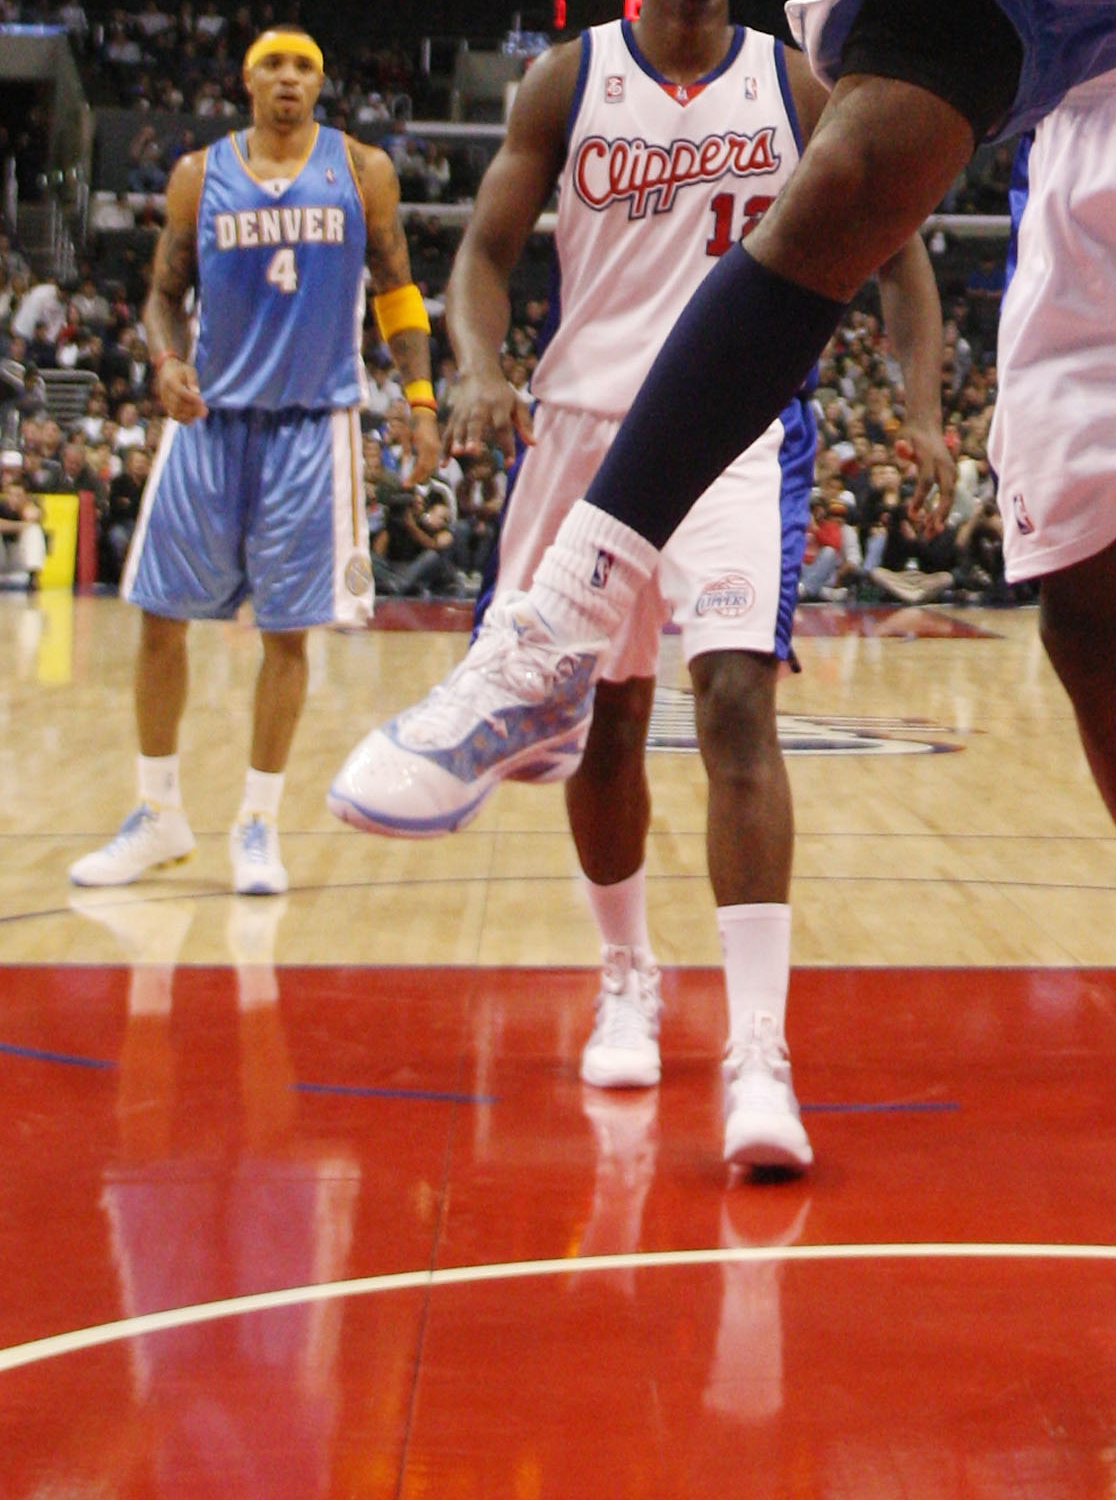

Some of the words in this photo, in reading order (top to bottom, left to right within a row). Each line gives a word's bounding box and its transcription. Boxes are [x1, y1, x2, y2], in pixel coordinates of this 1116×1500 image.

[574, 127, 782, 221] Clippers
[215, 206, 346, 250] DENVER
[706, 192, 776, 257] 1
[266, 246, 298, 294] 4
